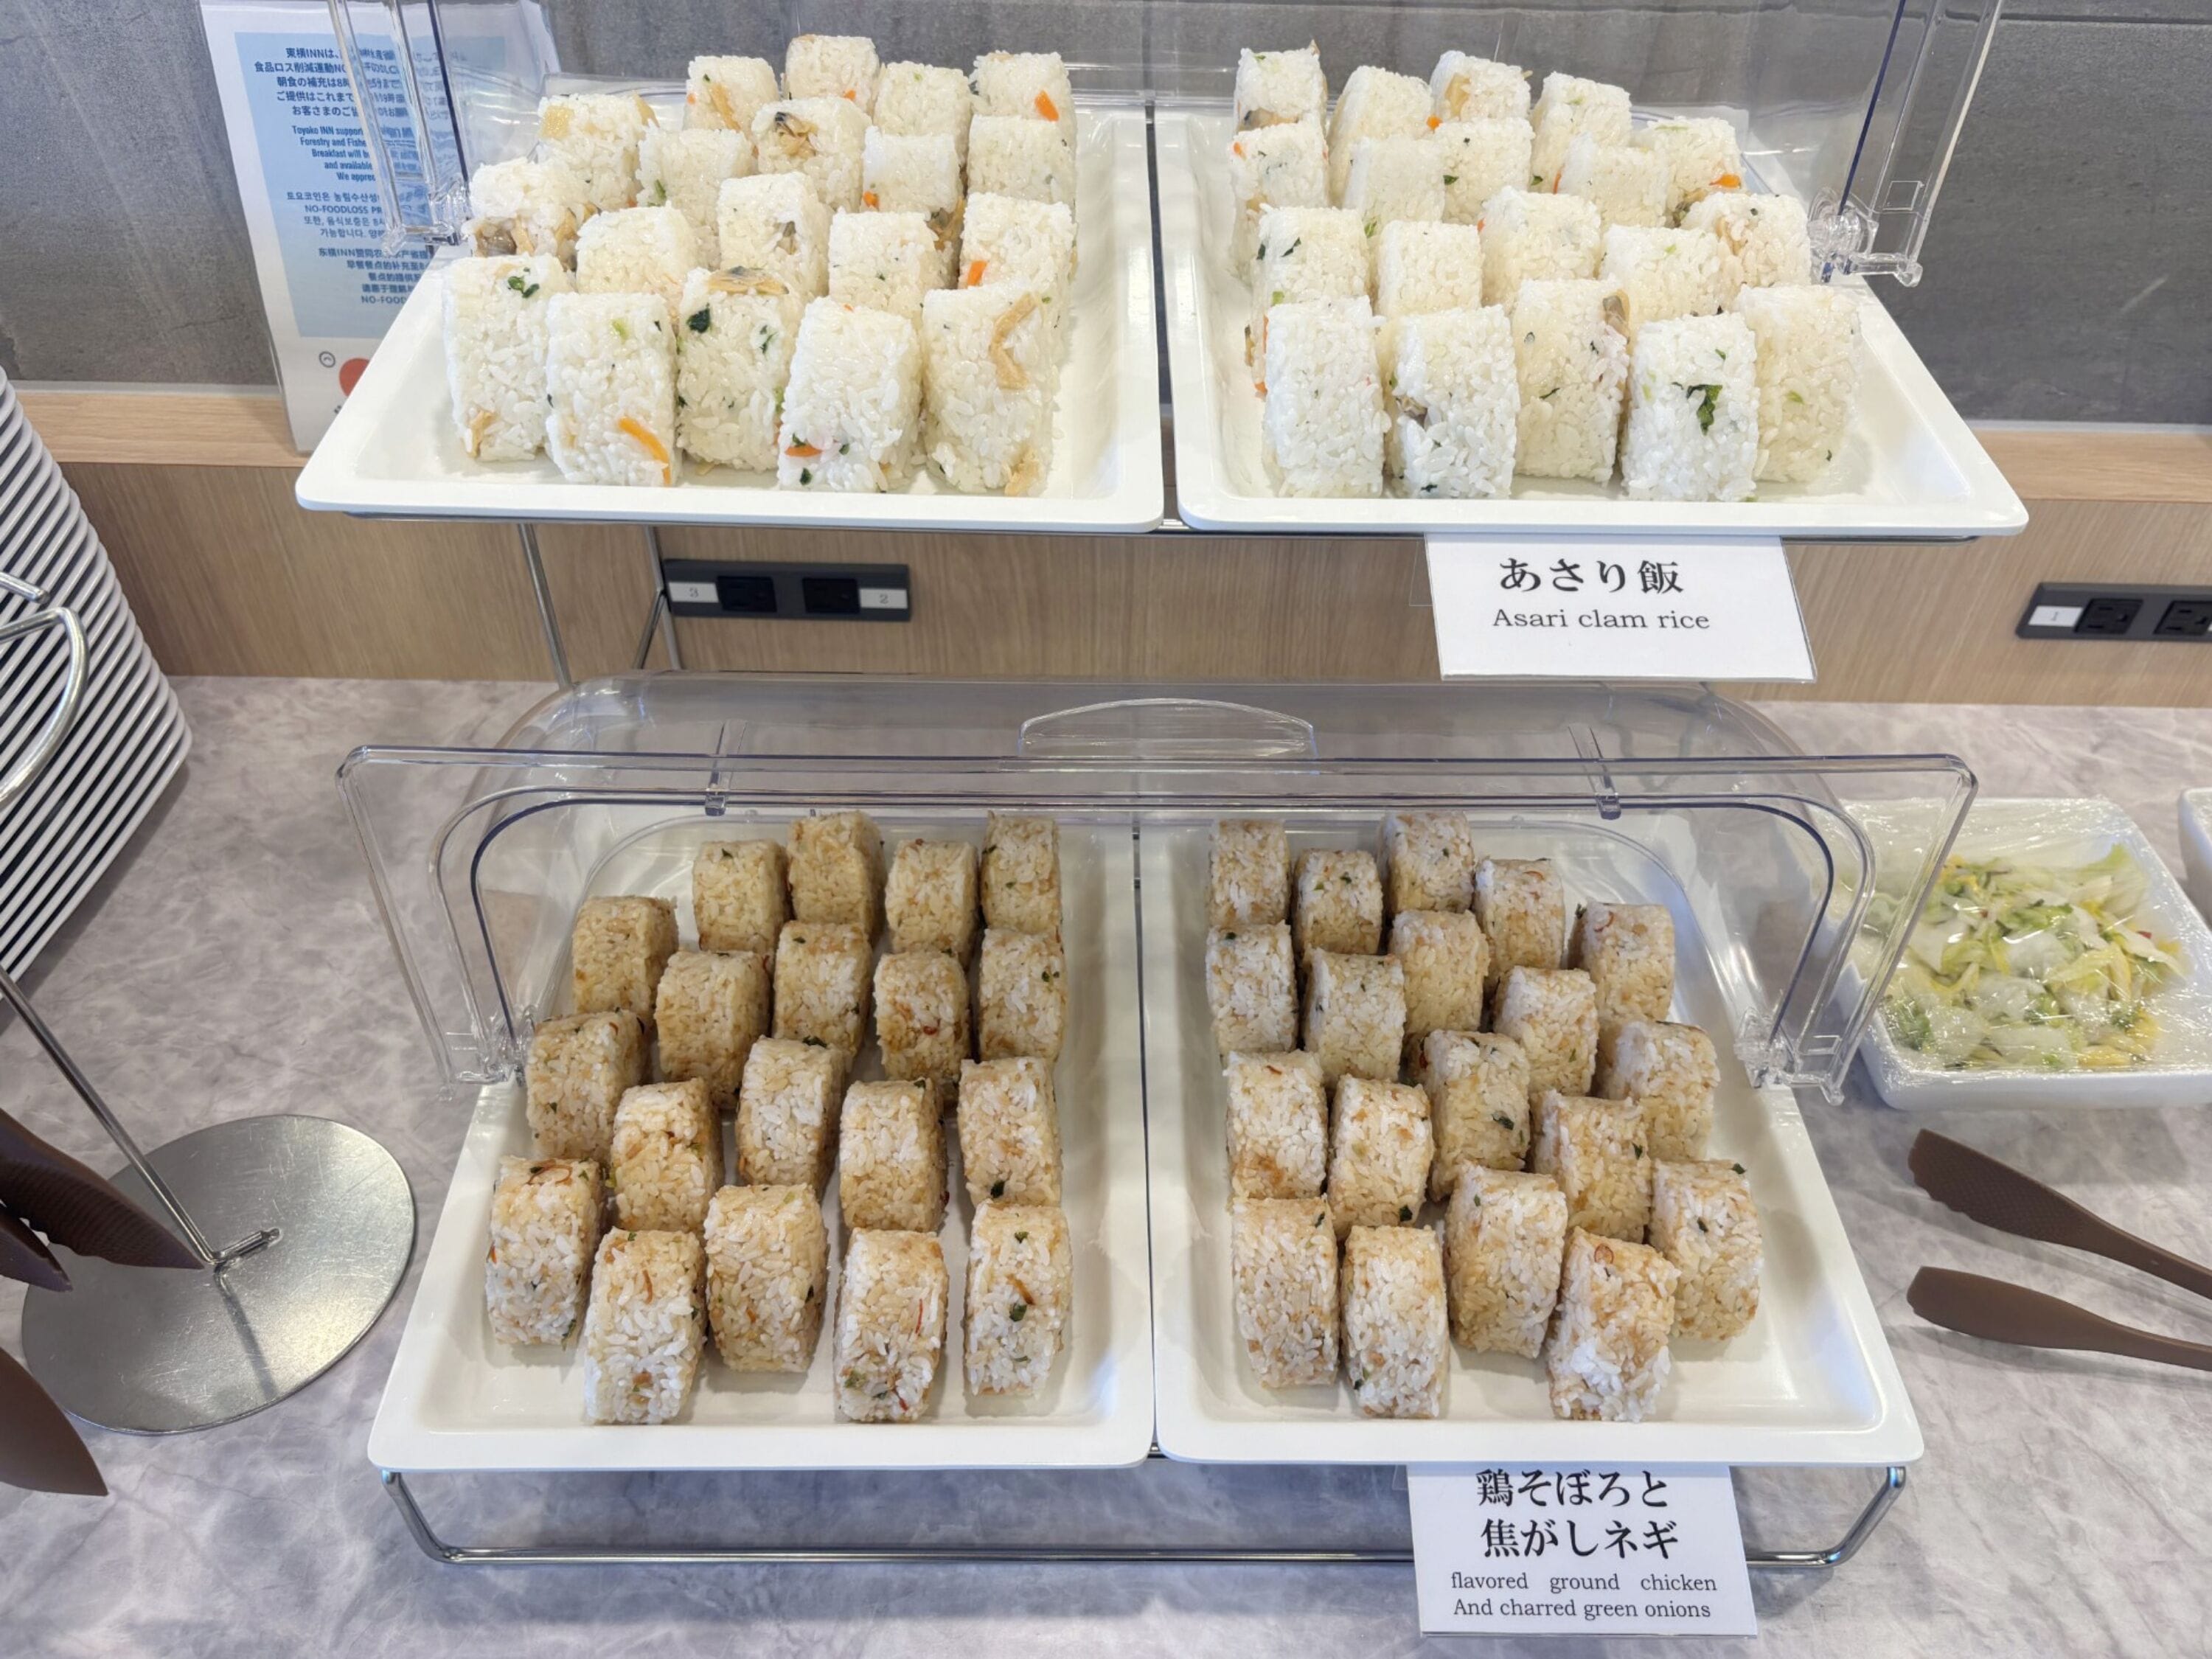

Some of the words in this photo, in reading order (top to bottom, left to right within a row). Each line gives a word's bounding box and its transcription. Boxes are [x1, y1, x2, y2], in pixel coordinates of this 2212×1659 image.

[320, 126, 334, 134] INN
[300, 137, 330, 147] Forestry
[332, 138, 345, 146] and
[312, 149, 346, 157] Breakfast
[305, 205, 369, 214] NO-FOODLOSS
[1500, 558, 1683, 594] あさり飯
[1493, 609, 1568, 627] Asari
[1578, 610, 1648, 628] clam
[1658, 611, 1710, 629] rice
[1476, 1469, 1667, 1507] 鶏そぼろと
[1481, 1519, 1678, 1559] 焦がしネギ
[1451, 1573, 1528, 1590] flavored
[1550, 1574, 1619, 1593] ground
[1641, 1574, 1717, 1591] chicken
[1454, 1599, 1492, 1616] And
[1500, 1599, 1576, 1617] charred
[1584, 1604, 1638, 1621] green
[1645, 1601, 1711, 1618] onions
